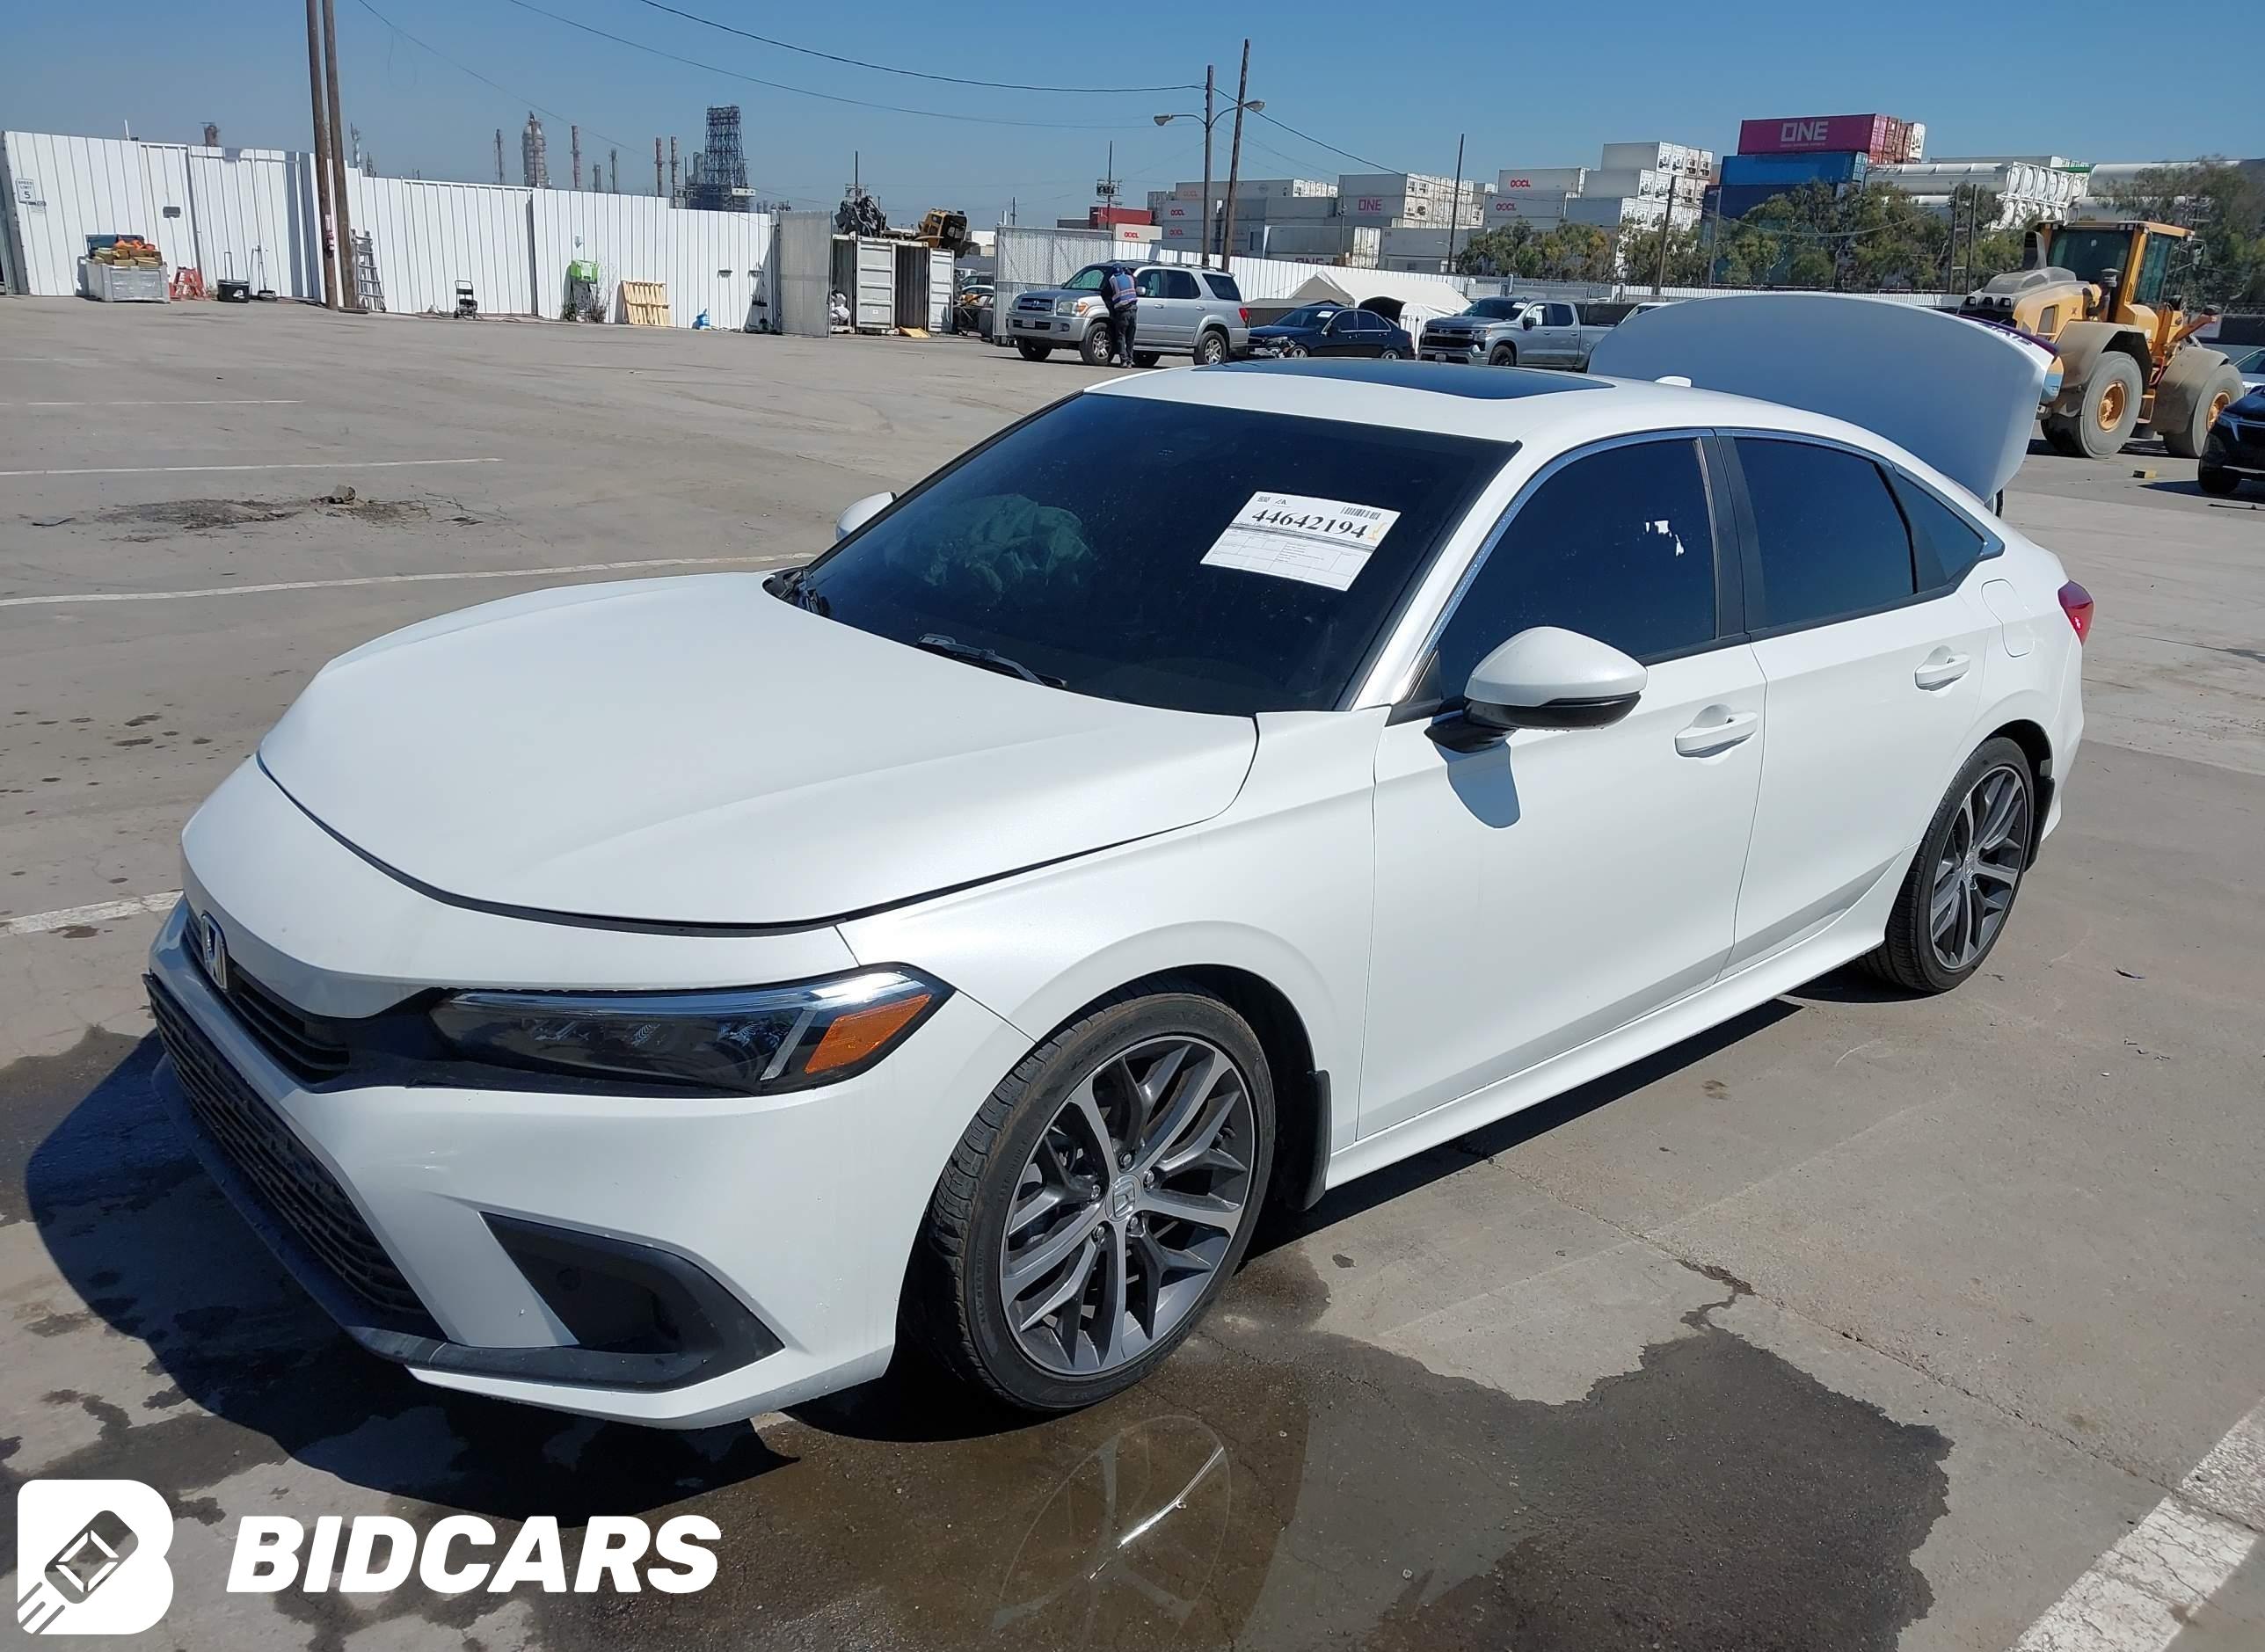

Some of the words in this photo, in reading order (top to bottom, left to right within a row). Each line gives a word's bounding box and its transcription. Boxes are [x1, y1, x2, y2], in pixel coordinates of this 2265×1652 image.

[1781, 121, 1829, 142] ONE
[1510, 178, 1531, 187] OOCL
[24, 191, 31, 200] 5
[1358, 199, 1383, 211] ONE
[1496, 202, 1517, 211] OOCL
[1251, 508, 1370, 539] 44642194
